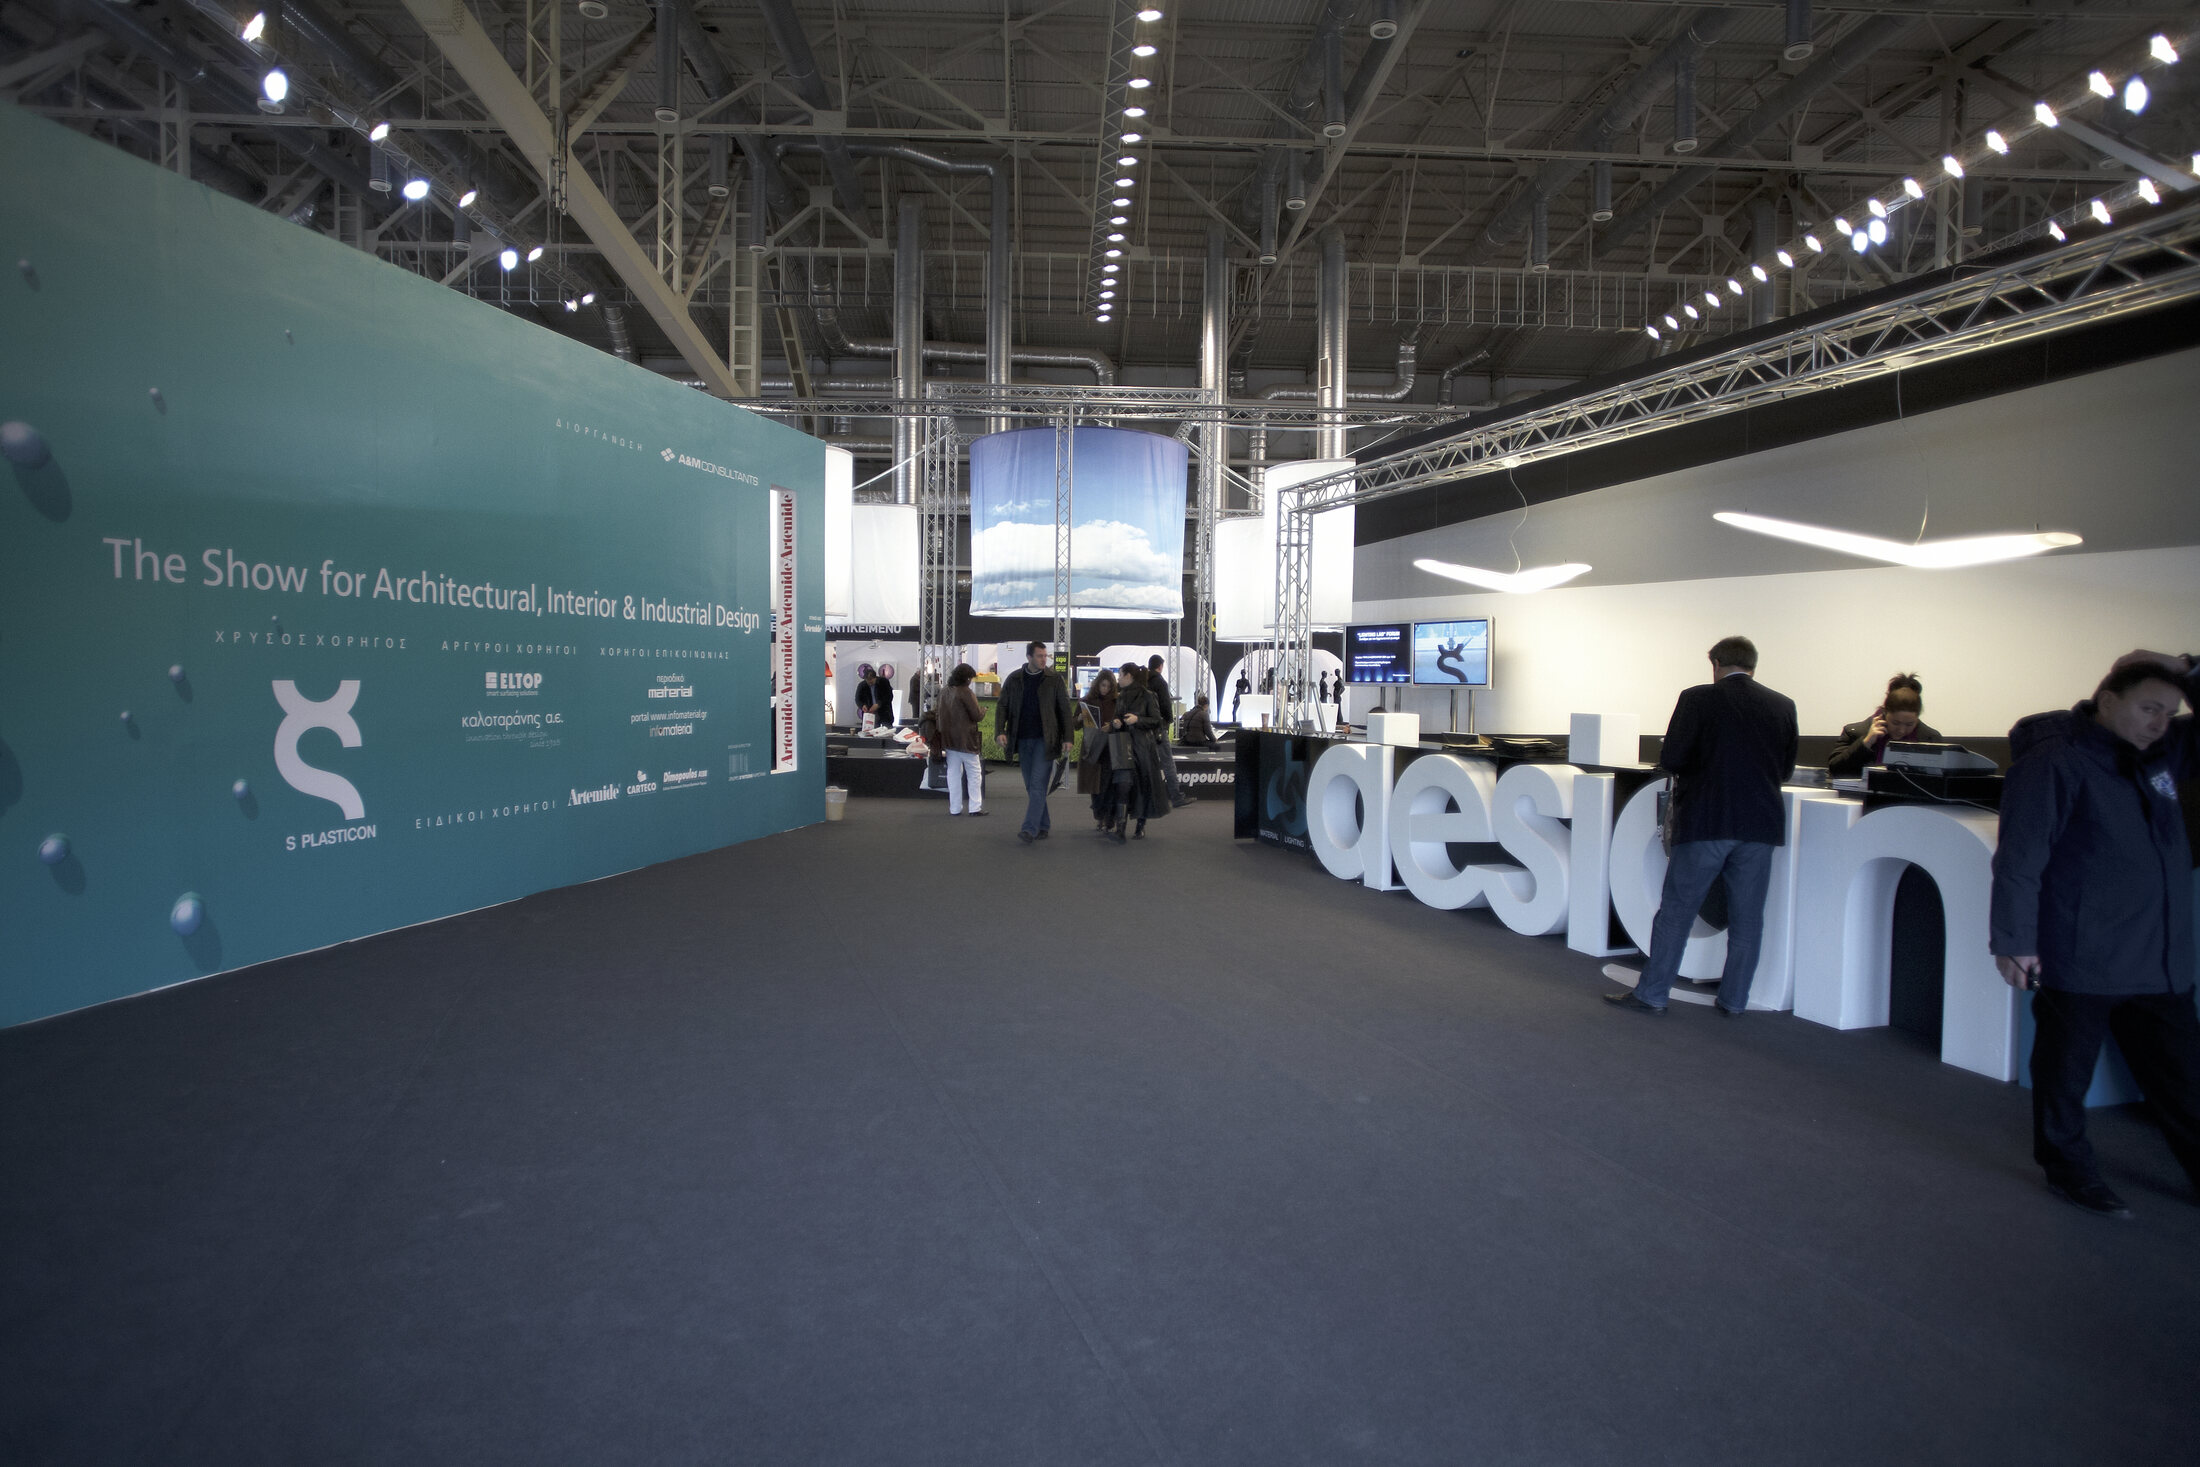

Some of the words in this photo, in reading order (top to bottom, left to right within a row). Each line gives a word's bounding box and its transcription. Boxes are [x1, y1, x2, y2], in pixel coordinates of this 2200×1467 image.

[102, 537, 187, 583] The
[202, 549, 308, 592] Show
[320, 560, 366, 598] for
[372, 568, 542, 617] Architectural,
[548, 586, 617, 620] Interior
[622, 595, 637, 621] &
[641, 597, 711, 627] Industrial
[716, 605, 760, 634] Design
[215, 630, 307, 646] ΧΡΥΣΟΣ
[316, 634, 407, 649] ΧΟΡΗΓΟΣ
[441, 640, 509, 654] ΑΡΓΥΡΟΙ
[517, 644, 576, 656] ΧΟΡΗΓΟΙ
[500, 672, 542, 689] ELTOP
[648, 685, 693, 698] material
[461, 710, 541, 731] καλοταράνης
[567, 784, 620, 807] Artemide
[626, 781, 657, 796] CARTECO
[415, 810, 484, 830] ΕΙΔΙΚΟΙ
[492, 800, 556, 818] ΧΟΡΗΓΟΙ
[286, 836, 297, 851] S
[301, 824, 377, 848] PLASTICON
